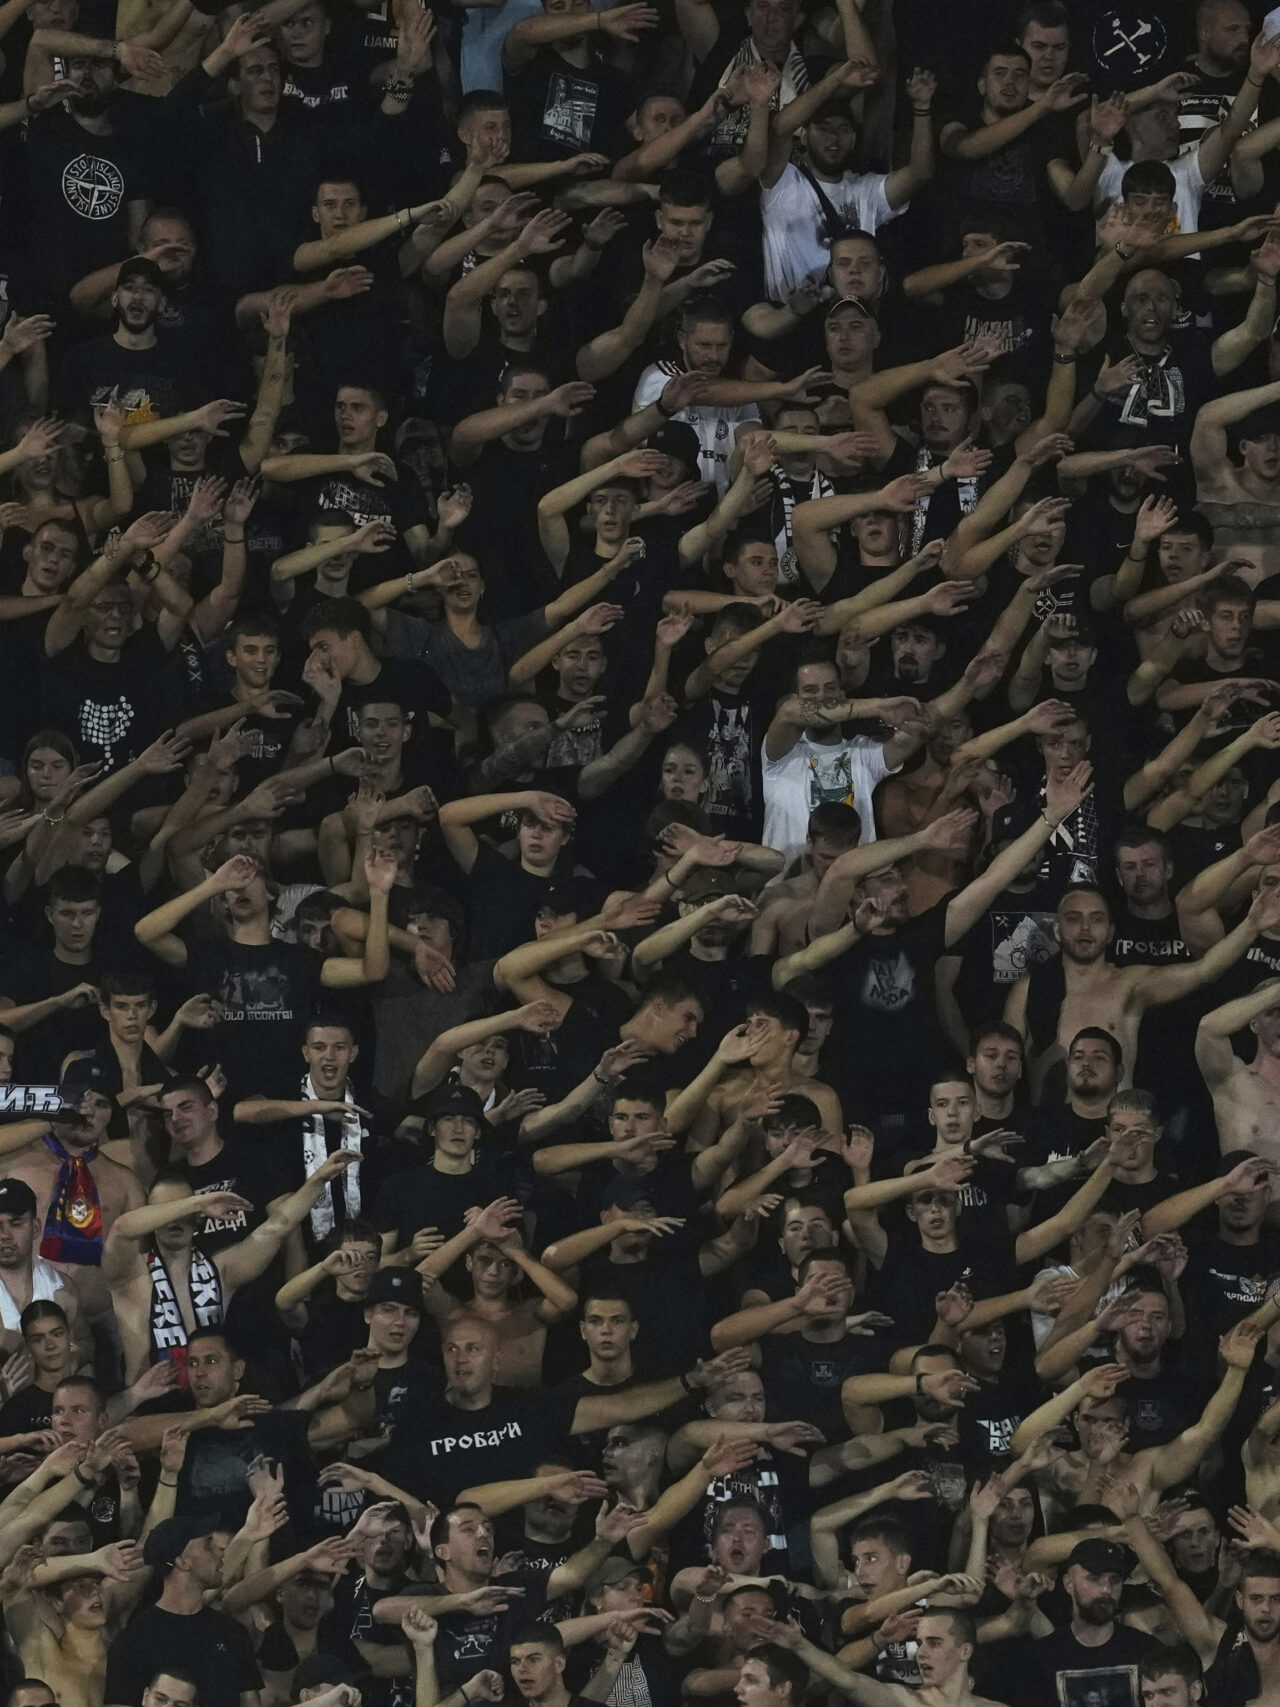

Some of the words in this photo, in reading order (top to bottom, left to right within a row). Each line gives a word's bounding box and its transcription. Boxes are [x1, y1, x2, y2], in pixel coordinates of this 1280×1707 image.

[1115, 939, 1191, 957] ГРОБАР
[225, 1010, 244, 1021] OLO
[1224, 1291, 1264, 1303] АРТИЗАН
[431, 1422, 523, 1456] ГРОБАРИ
